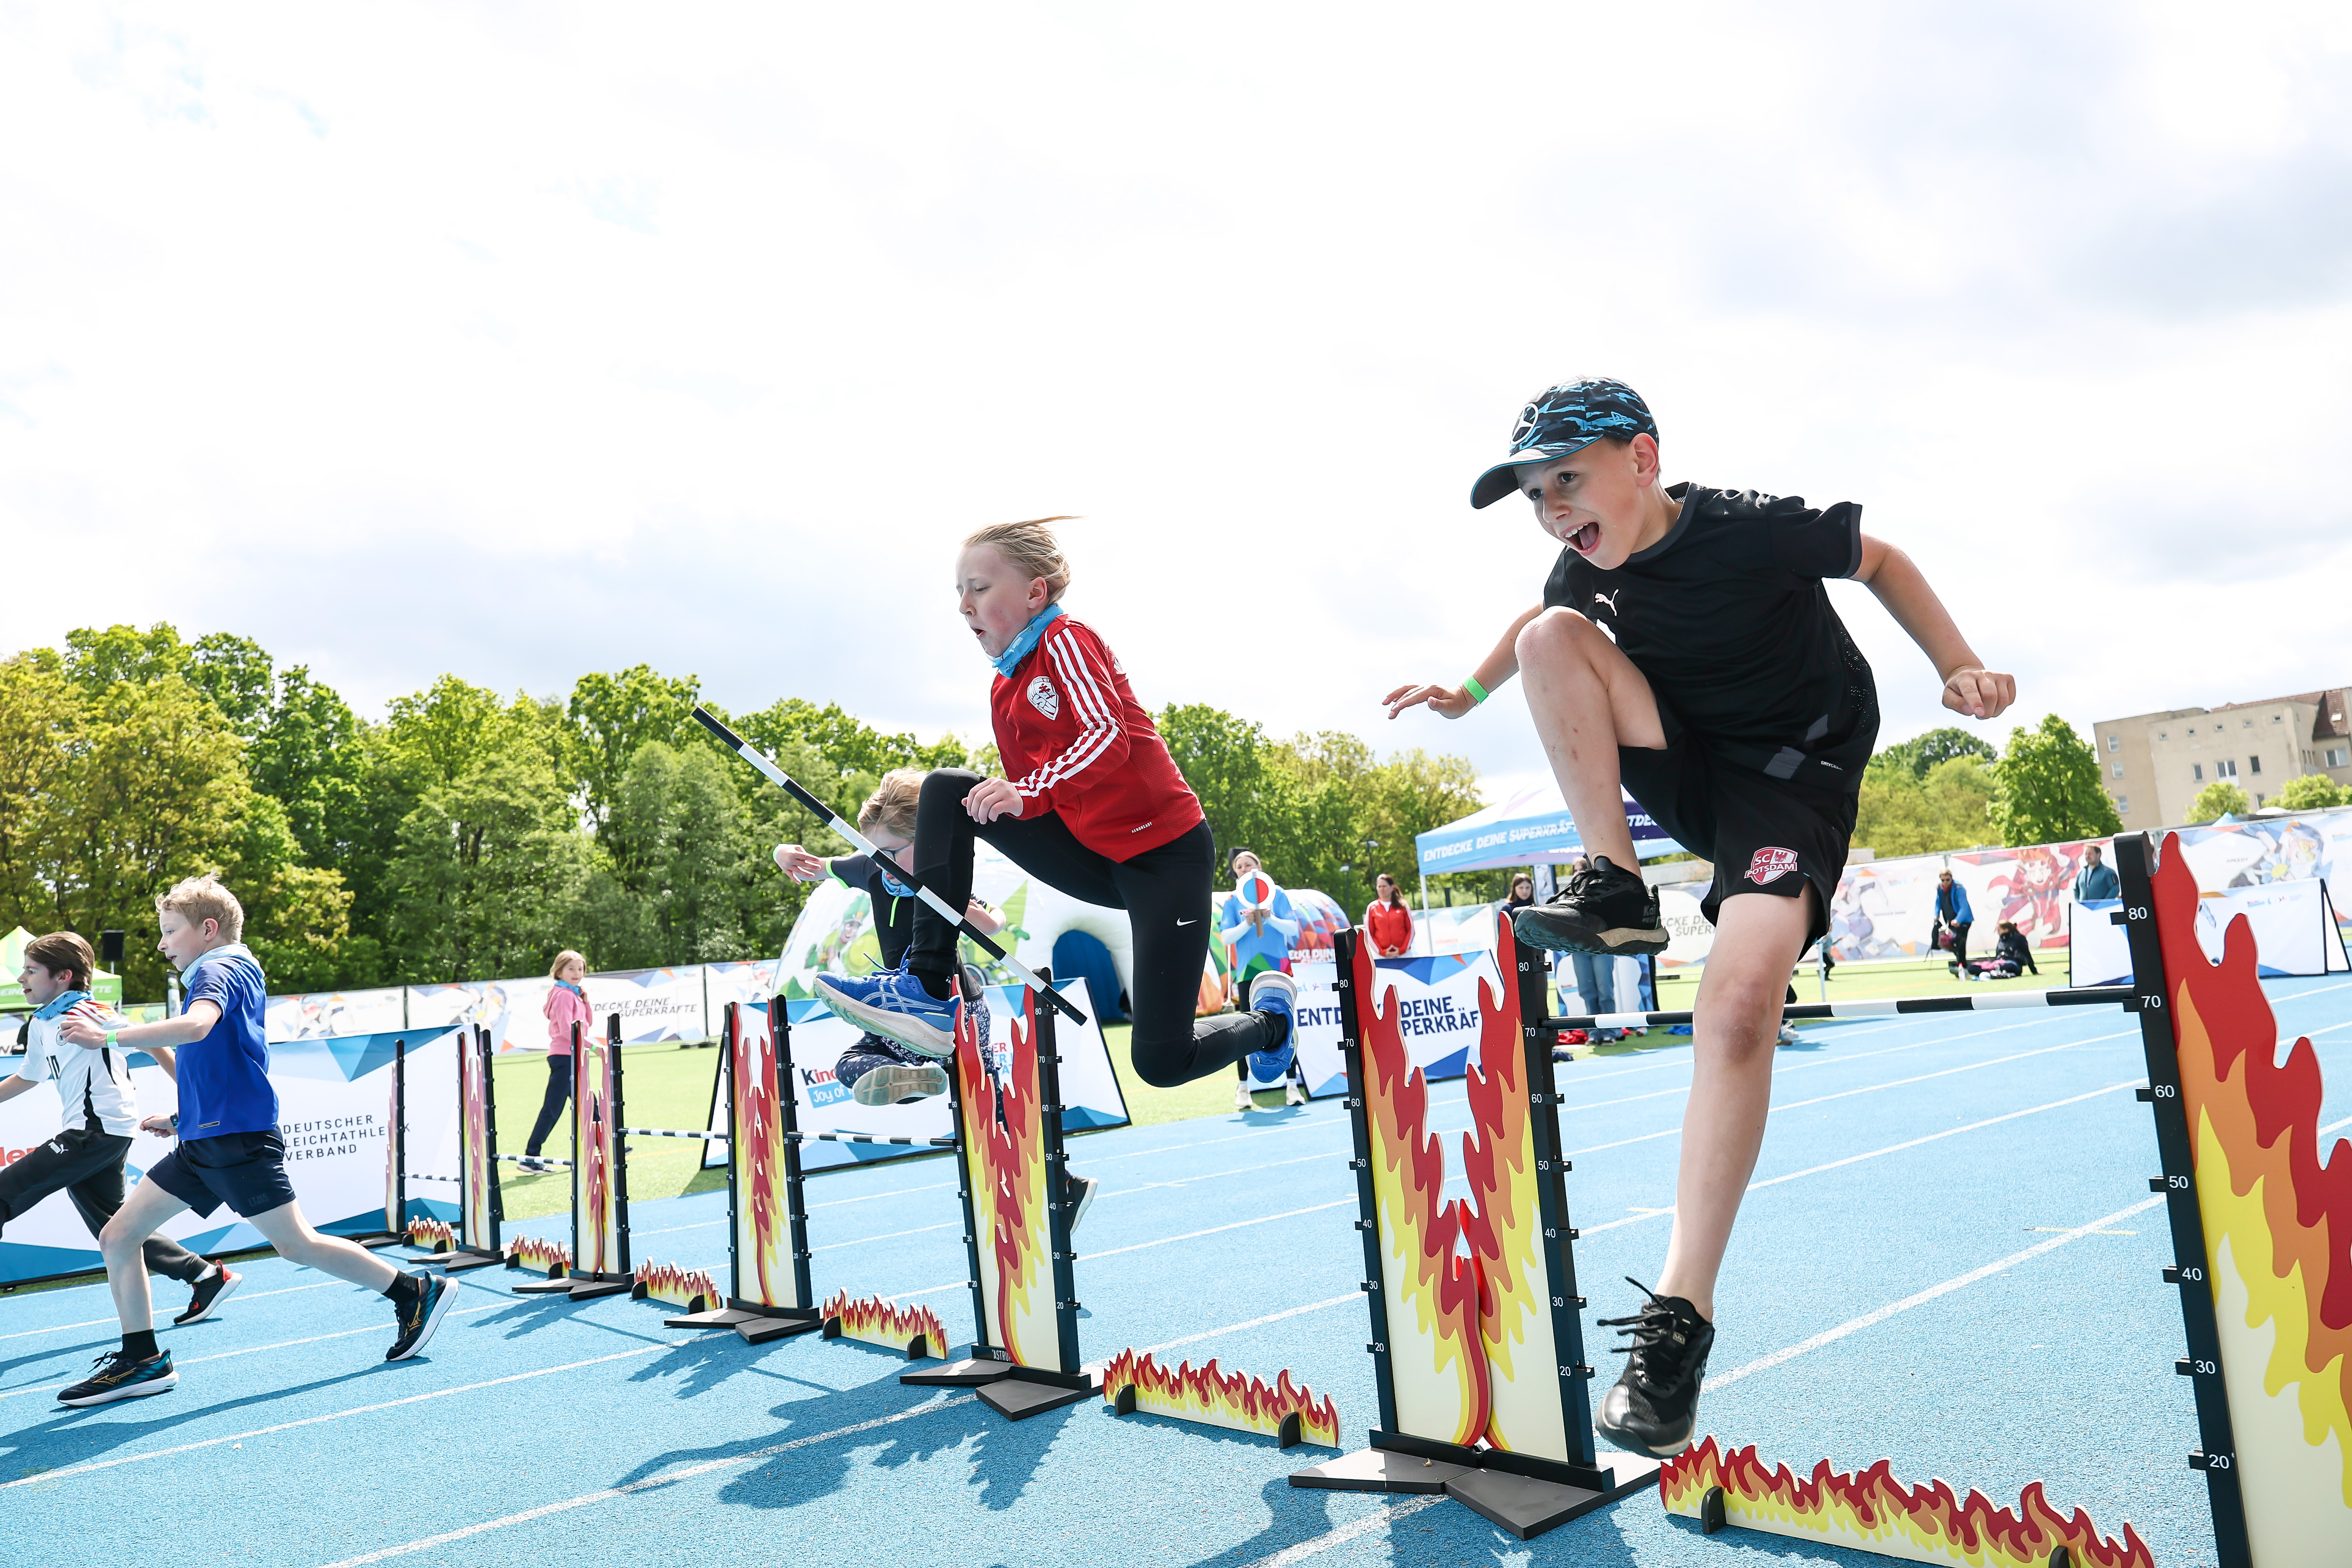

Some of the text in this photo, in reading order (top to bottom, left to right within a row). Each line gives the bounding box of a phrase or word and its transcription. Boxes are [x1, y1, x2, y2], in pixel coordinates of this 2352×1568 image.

[1131, 821, 1152, 833] AEROREADY
[1423, 839, 1473, 862] ENTDECKE
[1476, 832, 1508, 849] DEINE
[1755, 854, 1770, 866] SC
[1747, 864, 1795, 877] POTSDAM
[2128, 907, 2147, 920] 80
[1519, 962, 1529, 972] 80
[1339, 979, 1348, 988] 80
[593, 997, 670, 1011] DECKE DEINE
[1400, 996, 1454, 1018] DEINE
[2141, 995, 2161, 1008] 70
[1401, 1007, 1479, 1037] PERKRÄF
[1525, 1027, 1535, 1037] 70
[1345, 1038, 1354, 1047] 70
[813, 1089, 834, 1103] Joy
[2155, 1085, 2174, 1098] 60
[1351, 1098, 1360, 1107] 60
[1532, 1094, 1542, 1103] 60
[283, 1115, 373, 1134] DEUTSCHER
[285, 1144, 356, 1161] VERBAND
[1357, 1158, 1366, 1167] 50
[1538, 1160, 1549, 1170] 50
[2169, 1176, 2188, 1189] 50
[1363, 1219, 1372, 1228] 40
[1545, 1228, 1556, 1238] 40
[2182, 1267, 2202, 1281] 40
[1369, 1280, 1378, 1290] 30
[1552, 1296, 1563, 1307] 30
[1375, 1342, 1384, 1352] 20
[1560, 1366, 1571, 1376] 20
[2195, 1360, 2215, 1374] 30
[2209, 1454, 2229, 1469] 20
